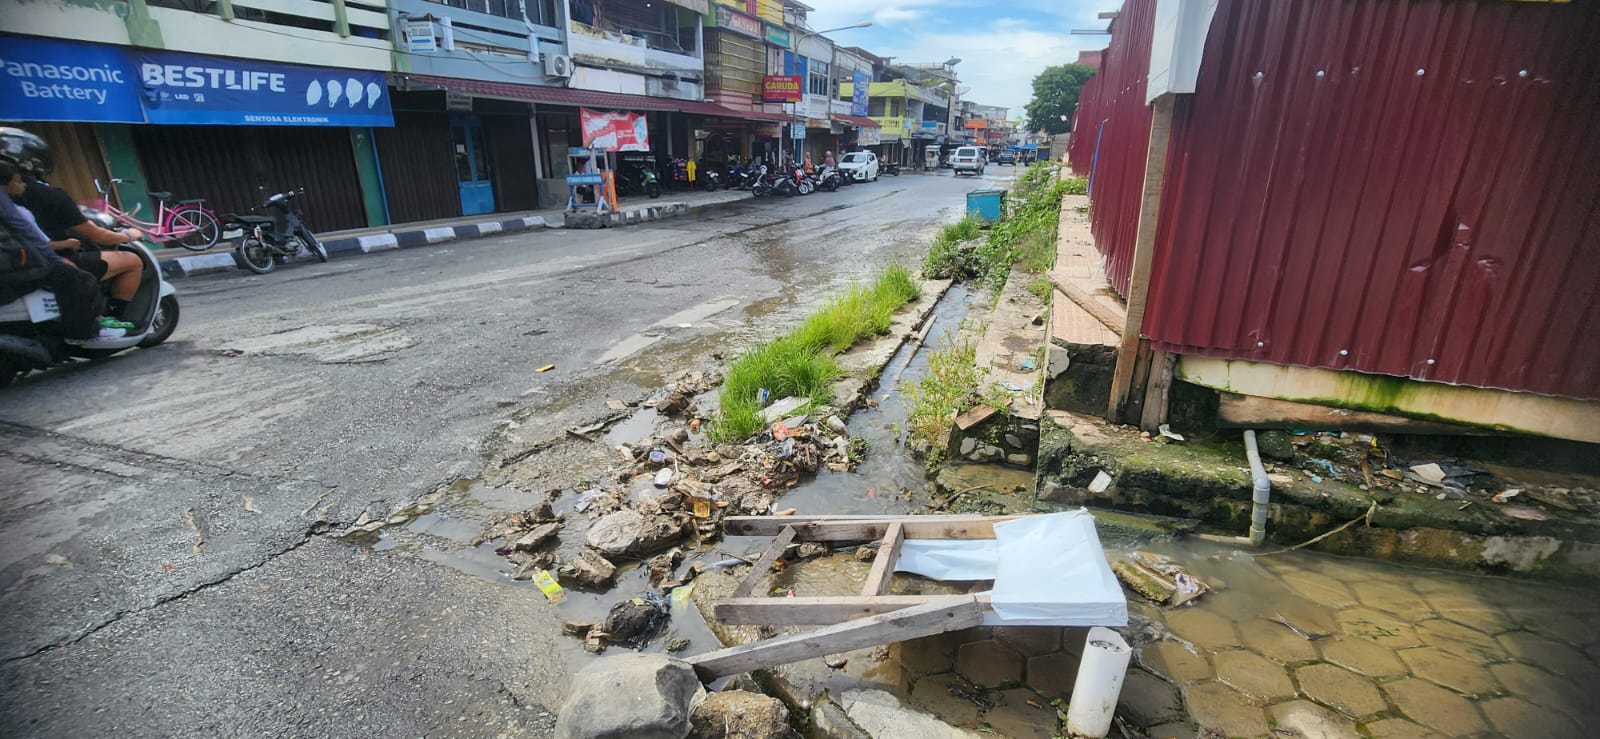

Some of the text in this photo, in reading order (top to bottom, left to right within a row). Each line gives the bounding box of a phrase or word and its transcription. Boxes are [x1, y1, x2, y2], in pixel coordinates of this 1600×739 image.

[142, 63, 286, 93] BESTLIFE
[765, 81, 799, 90] GARUDA
[21, 80, 107, 105] Battery
